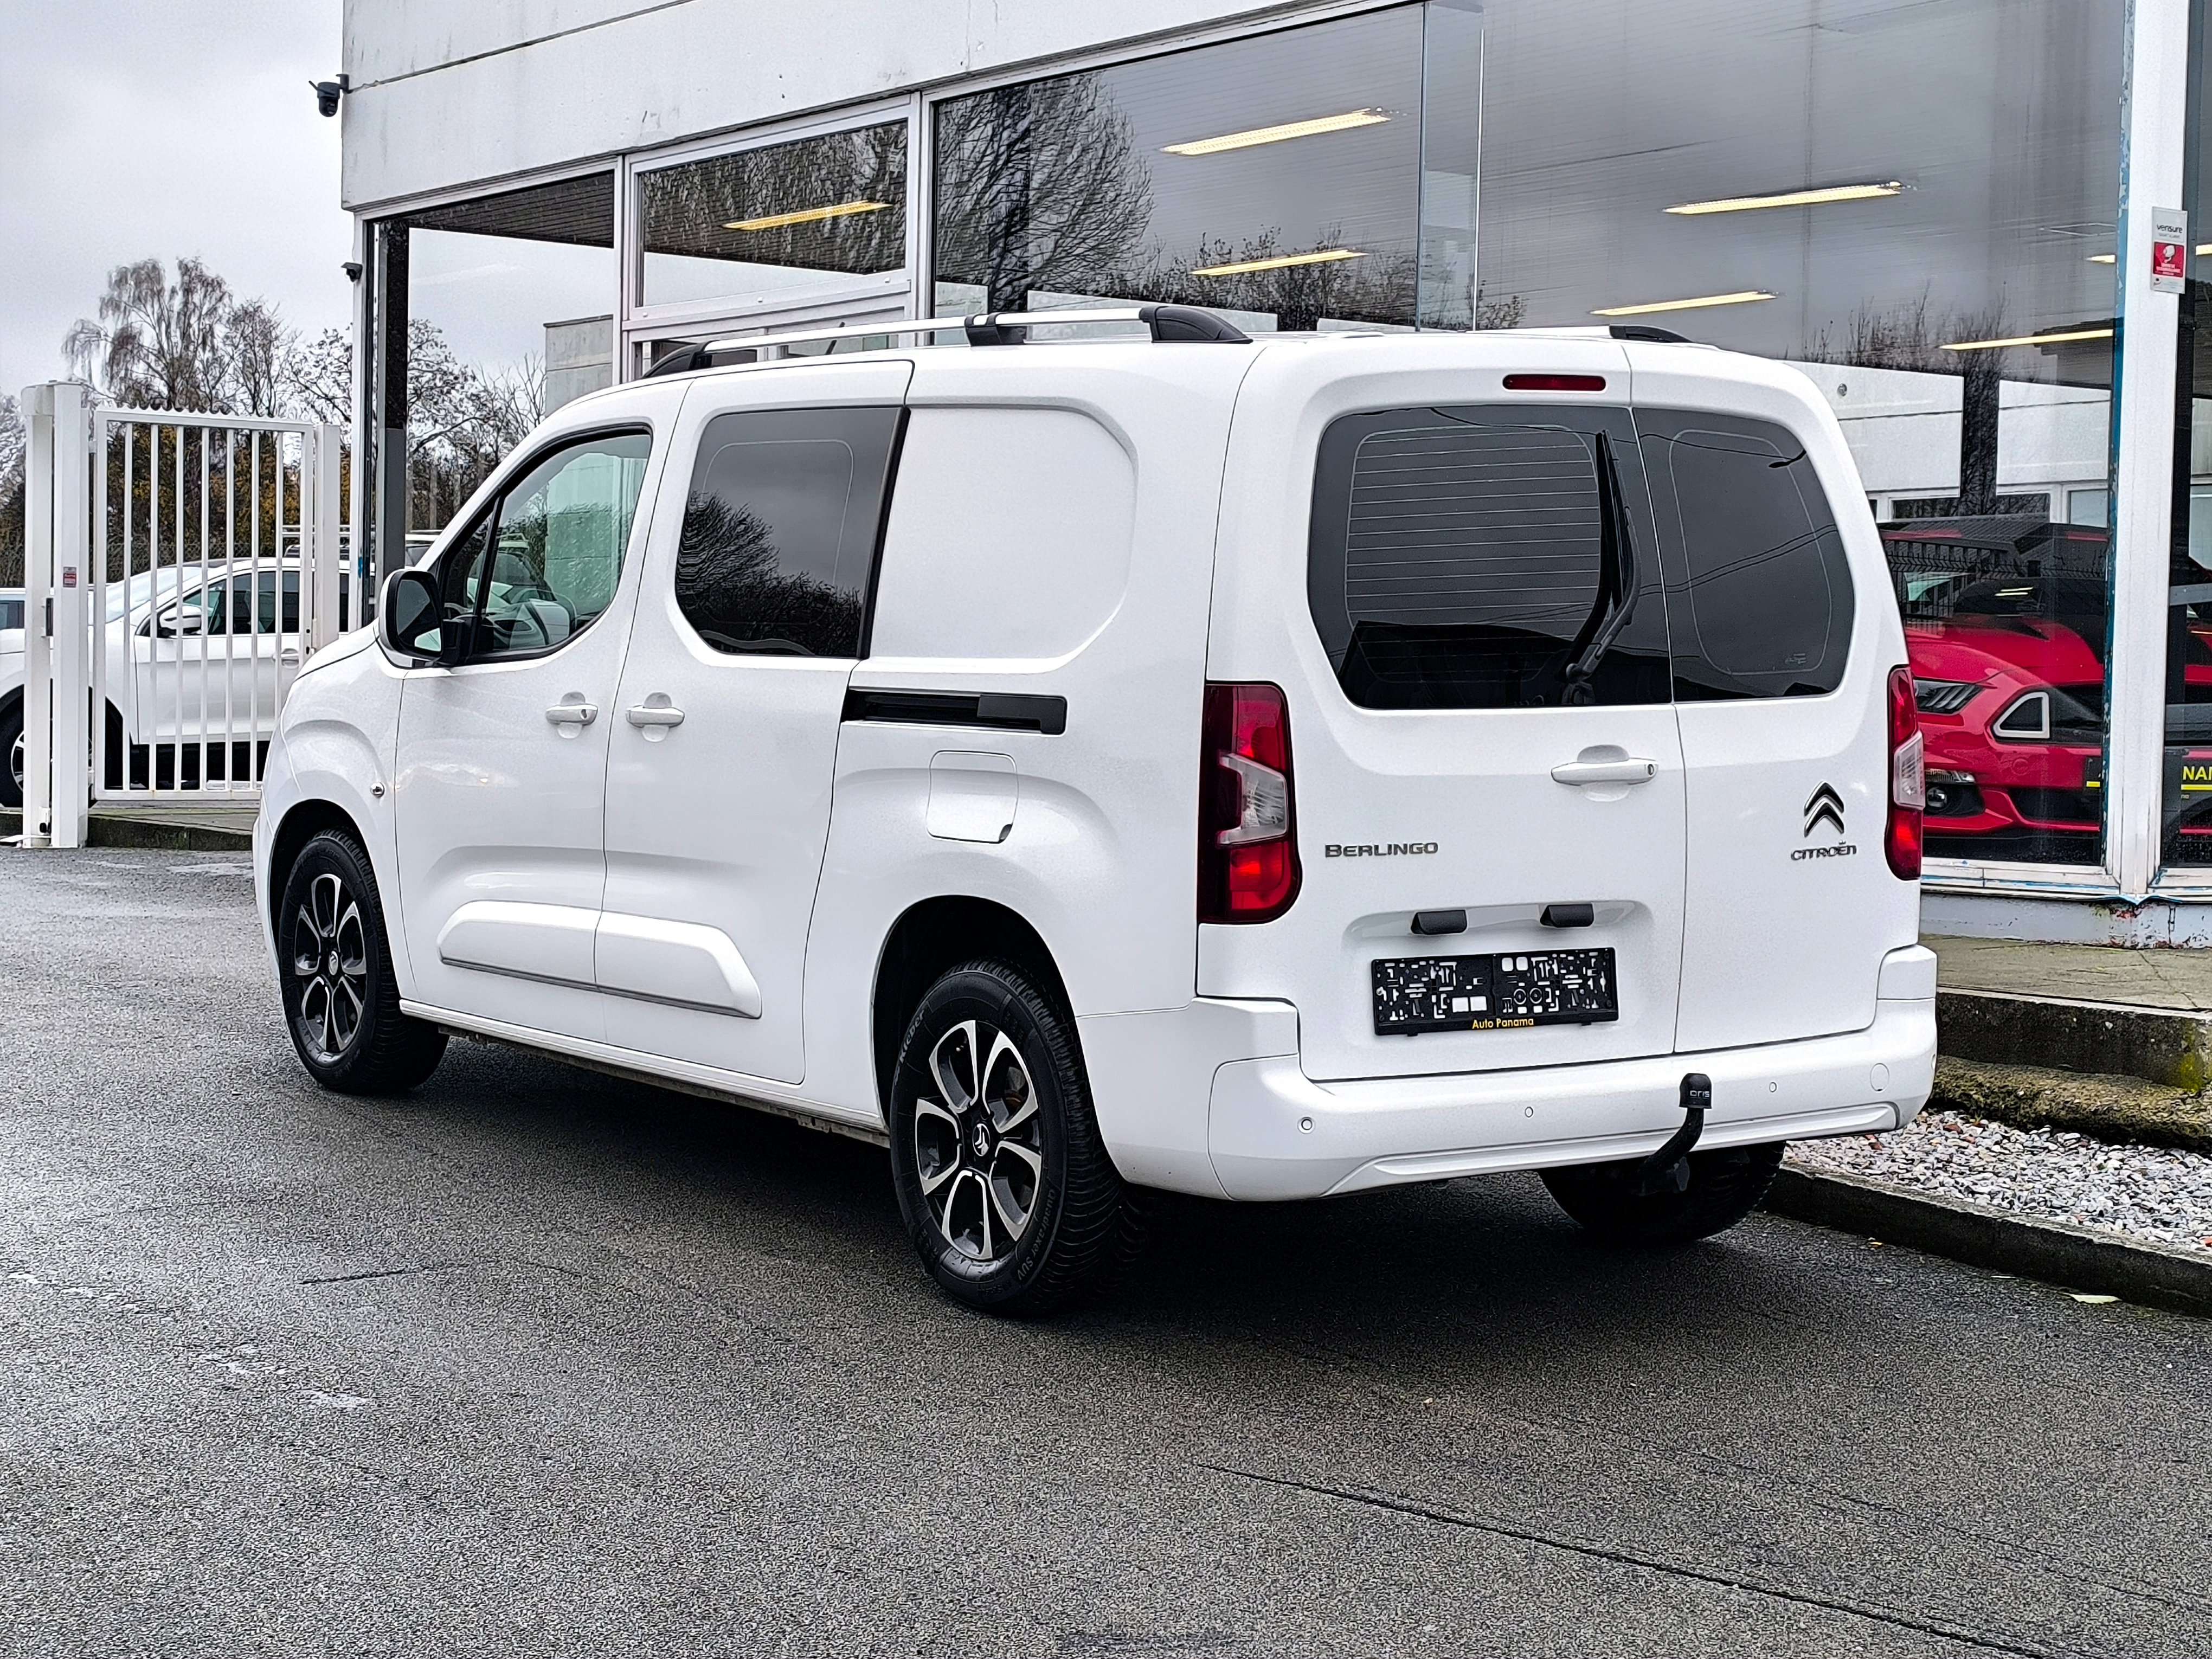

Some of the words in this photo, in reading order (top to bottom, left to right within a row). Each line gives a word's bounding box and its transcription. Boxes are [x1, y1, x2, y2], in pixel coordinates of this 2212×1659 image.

[2183, 766, 2212, 781] NA
[1325, 842, 1438, 858] BERLINGO
[1472, 1019, 1494, 1029] Auto
[1496, 1018, 1534, 1028] Panama
[1017, 1256, 1034, 1281] SUV
